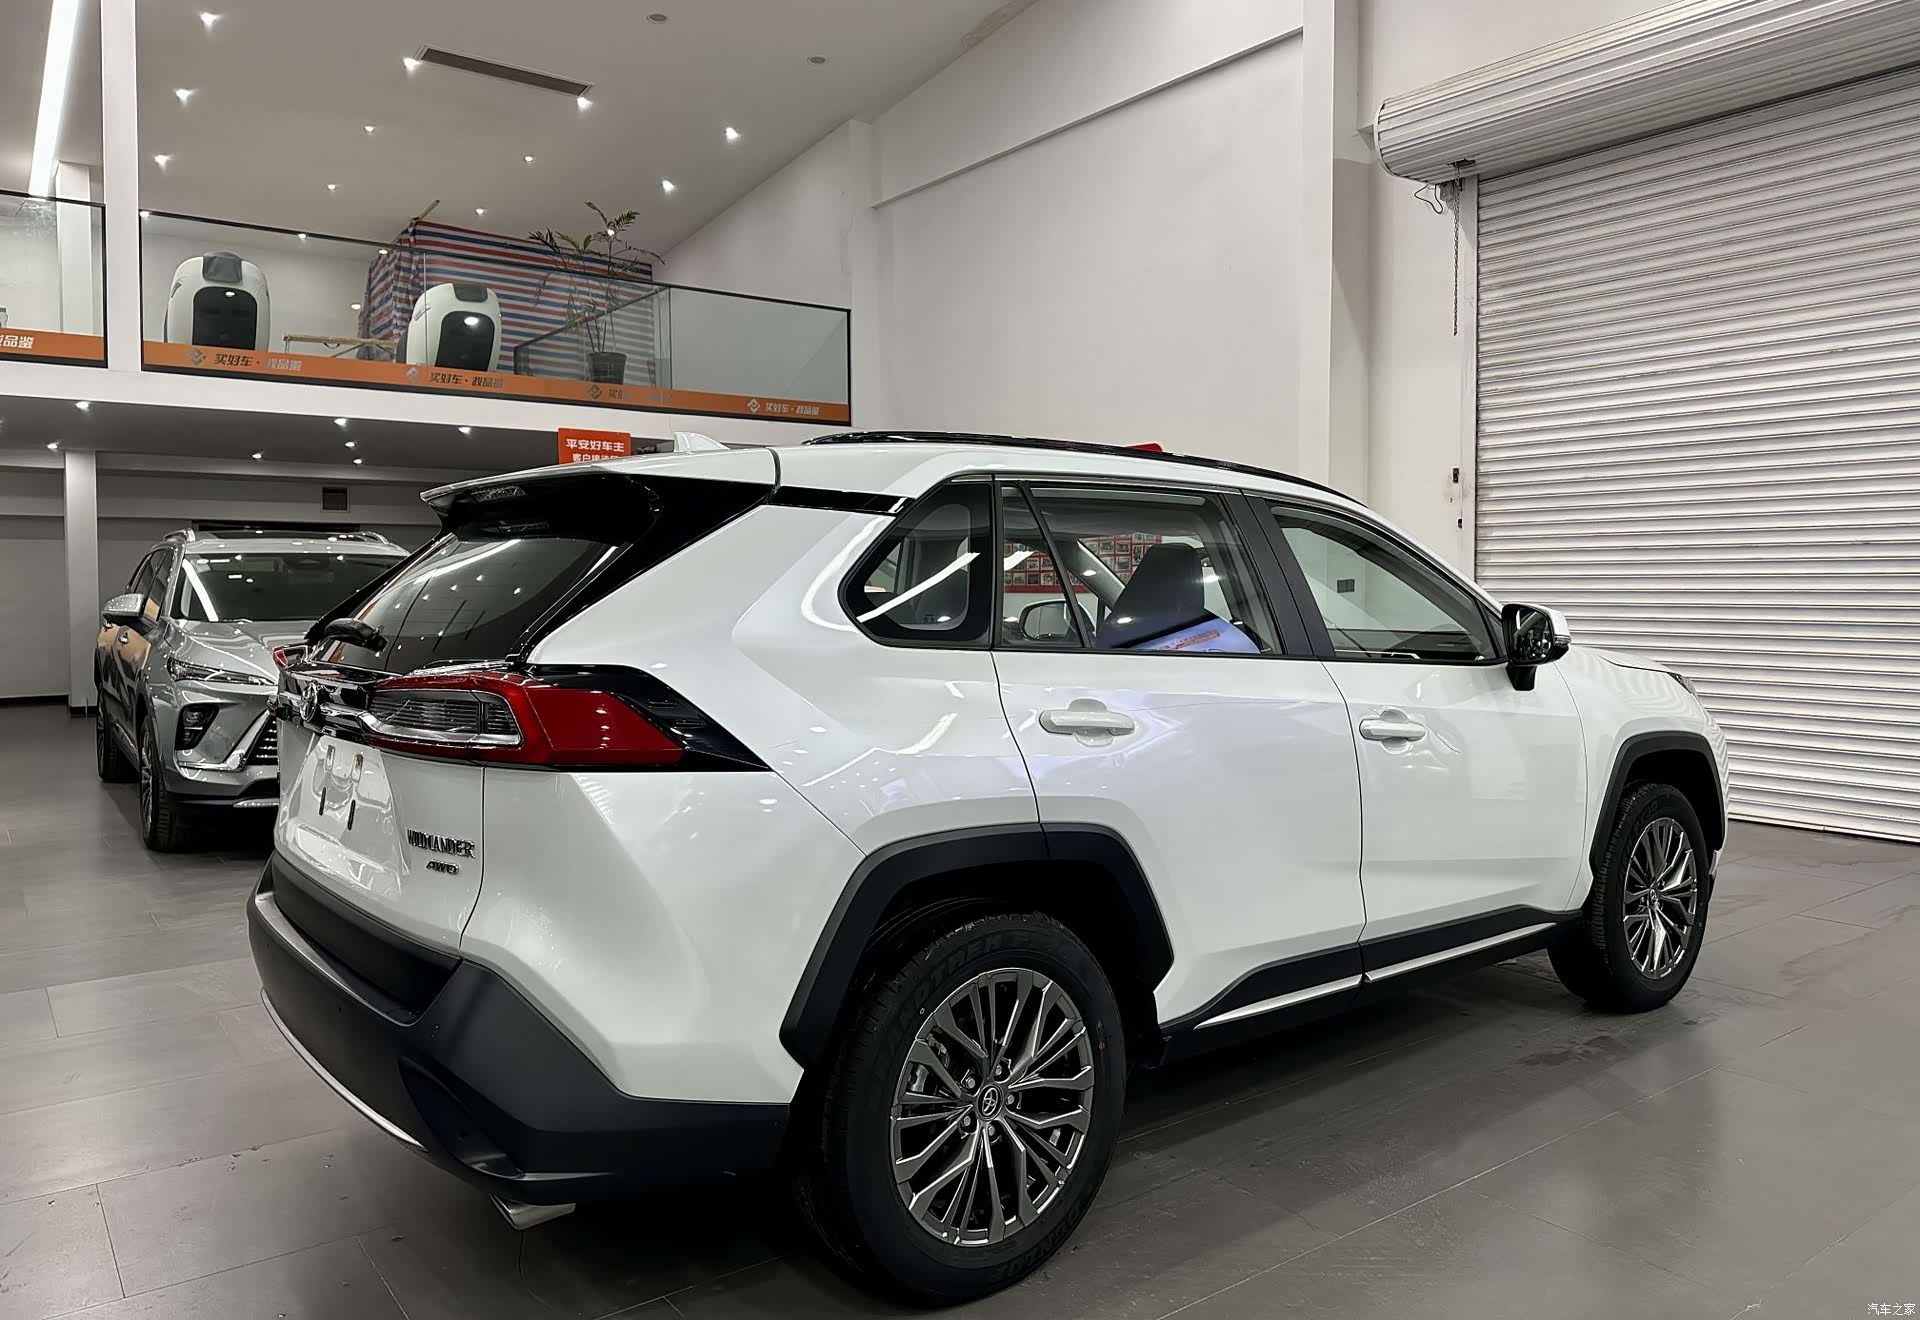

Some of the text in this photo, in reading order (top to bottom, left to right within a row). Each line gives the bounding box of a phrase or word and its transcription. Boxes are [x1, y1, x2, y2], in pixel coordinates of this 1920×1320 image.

[565, 438, 625, 452] 平安好车主
[407, 829, 476, 859] WILDLANDER
[425, 860, 460, 875] AWD
